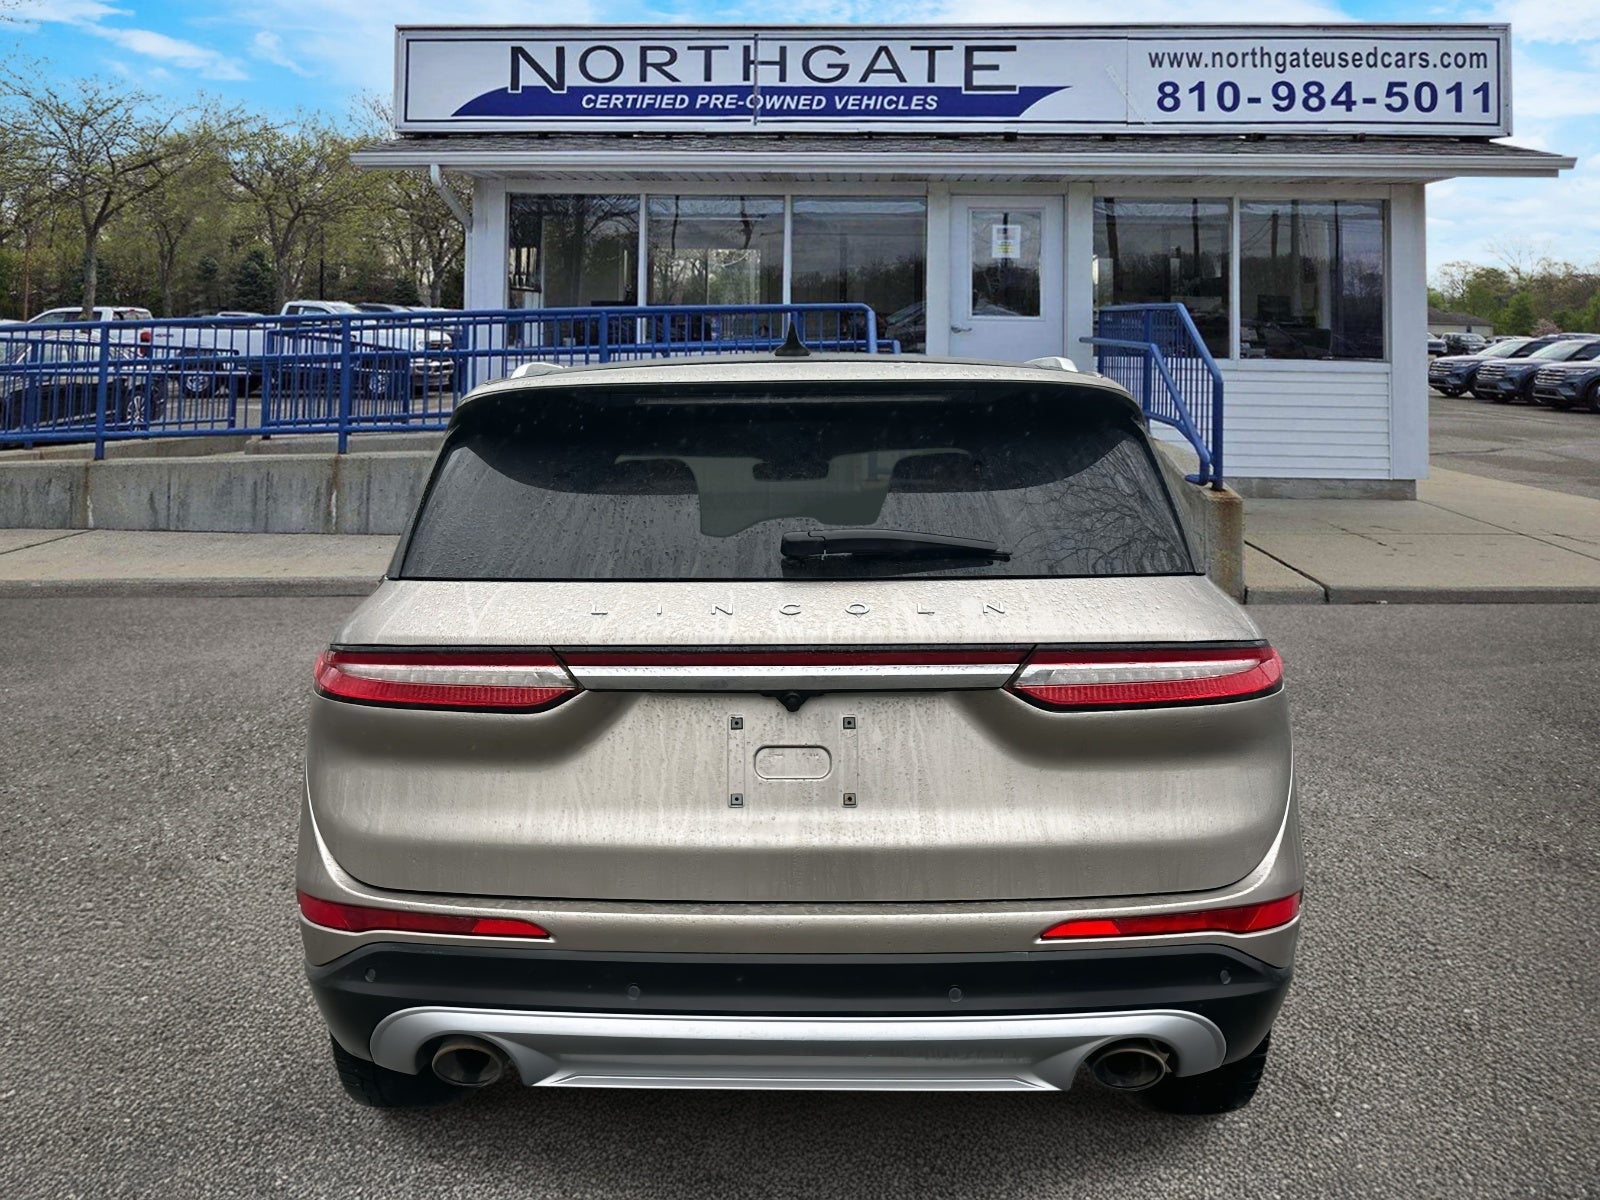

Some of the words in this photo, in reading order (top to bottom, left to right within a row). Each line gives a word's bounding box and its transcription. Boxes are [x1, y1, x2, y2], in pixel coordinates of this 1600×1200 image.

[508, 45, 1018, 93] NORTHGATE
[1148, 46, 1488, 73] www.northgateusedcars.com
[581, 94, 689, 109] CERTIFIED
[695, 94, 827, 110] PRE-OWNED
[834, 95, 938, 111] VEHICLES
[1156, 80, 1491, 114] 810-984-5011
[590, 602, 1006, 616] LINCOLN
